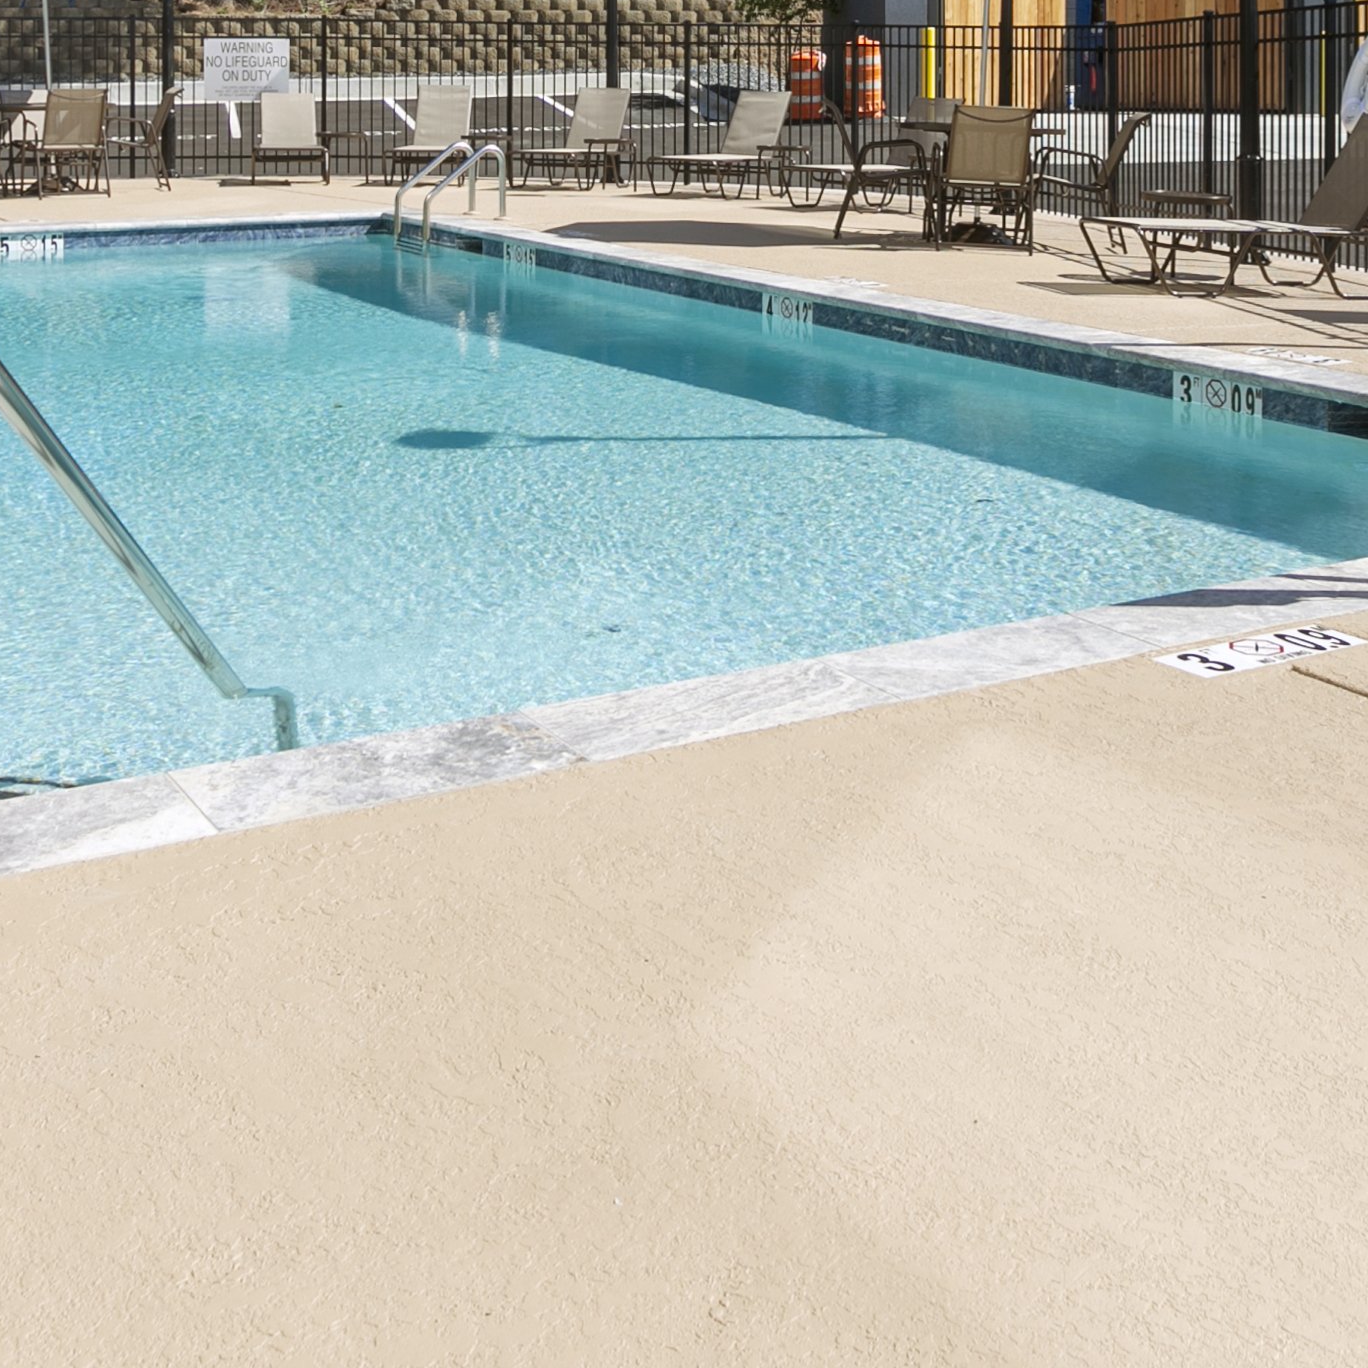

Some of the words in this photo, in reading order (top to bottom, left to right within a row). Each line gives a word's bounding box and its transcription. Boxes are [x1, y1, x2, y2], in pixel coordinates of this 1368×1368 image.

[220, 41, 273, 54] WARNING
[206, 55, 223, 69] NO
[225, 55, 288, 69] LIFEGUARD
[222, 69, 239, 82] ON
[242, 69, 272, 82] DUTY
[1180, 375, 1192, 403] 3
[1177, 653, 1235, 672] 3
